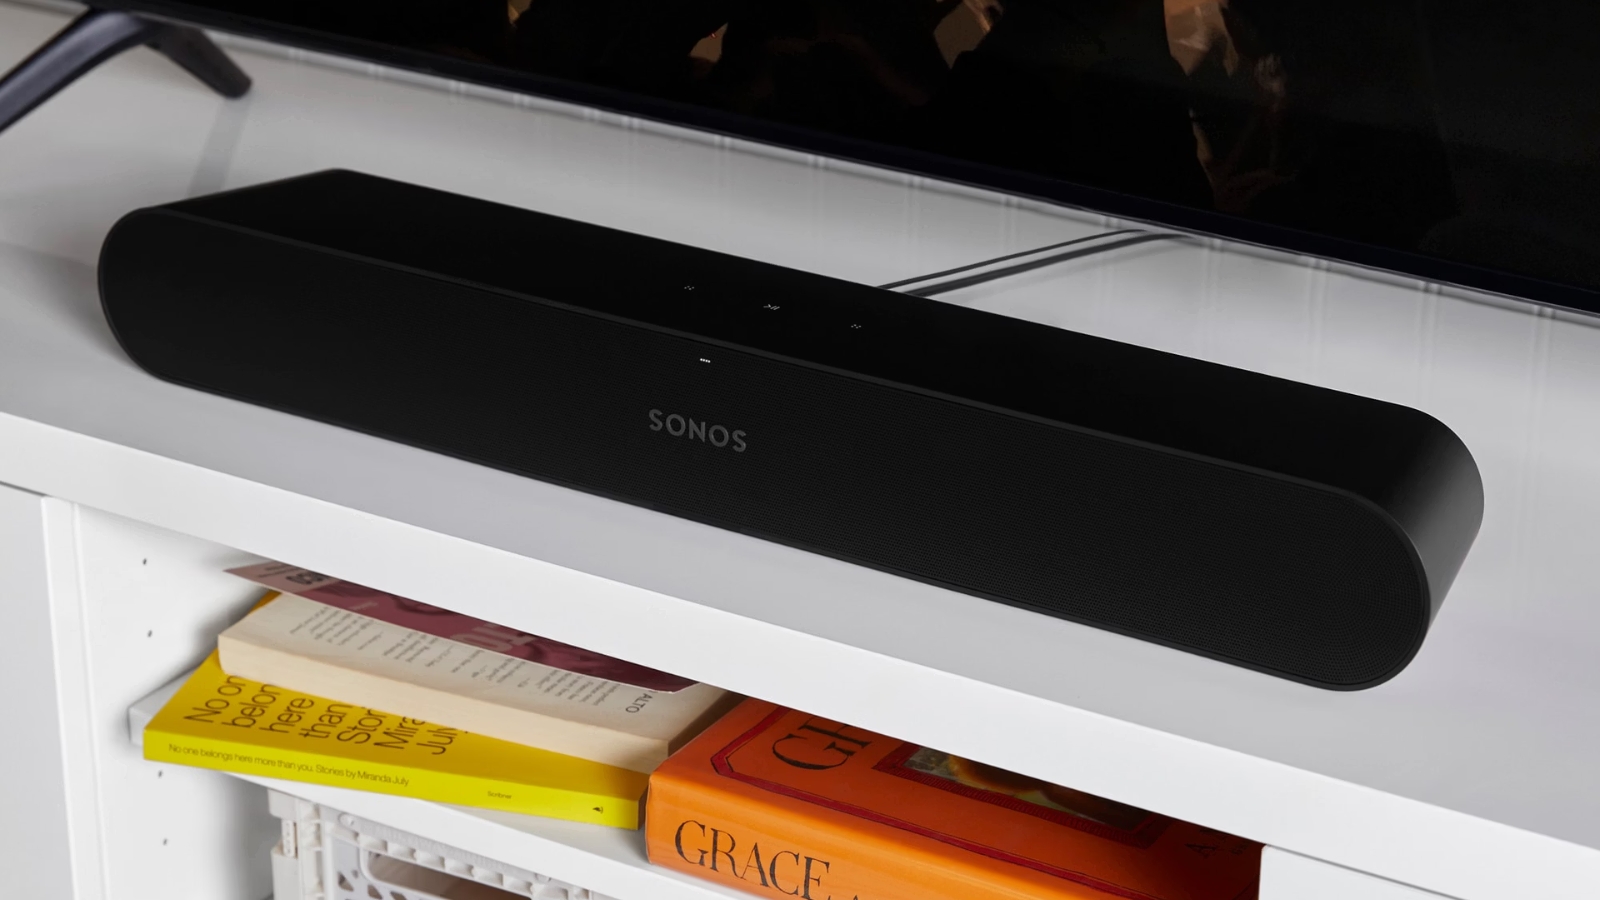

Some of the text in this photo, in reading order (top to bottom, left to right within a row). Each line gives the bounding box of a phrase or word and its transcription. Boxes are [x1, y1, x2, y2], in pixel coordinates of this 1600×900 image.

[649, 408, 747, 453] SONOS
[183, 699, 230, 723] No
[259, 698, 315, 734] here
[298, 703, 354, 739] than
[168, 743, 181, 753] No
[181, 746, 199, 756] one
[200, 748, 233, 762] belongs
[234, 754, 253, 763] here
[254, 757, 276, 767] more
[277, 759, 296, 769] than
[316, 764, 345, 777] Stories
[345, 768, 357, 780] by
[357, 770, 392, 783] Miranda
[392, 775, 410, 787] July
[487, 790, 512, 800] Scribner
[674, 819, 830, 900] GRACE
